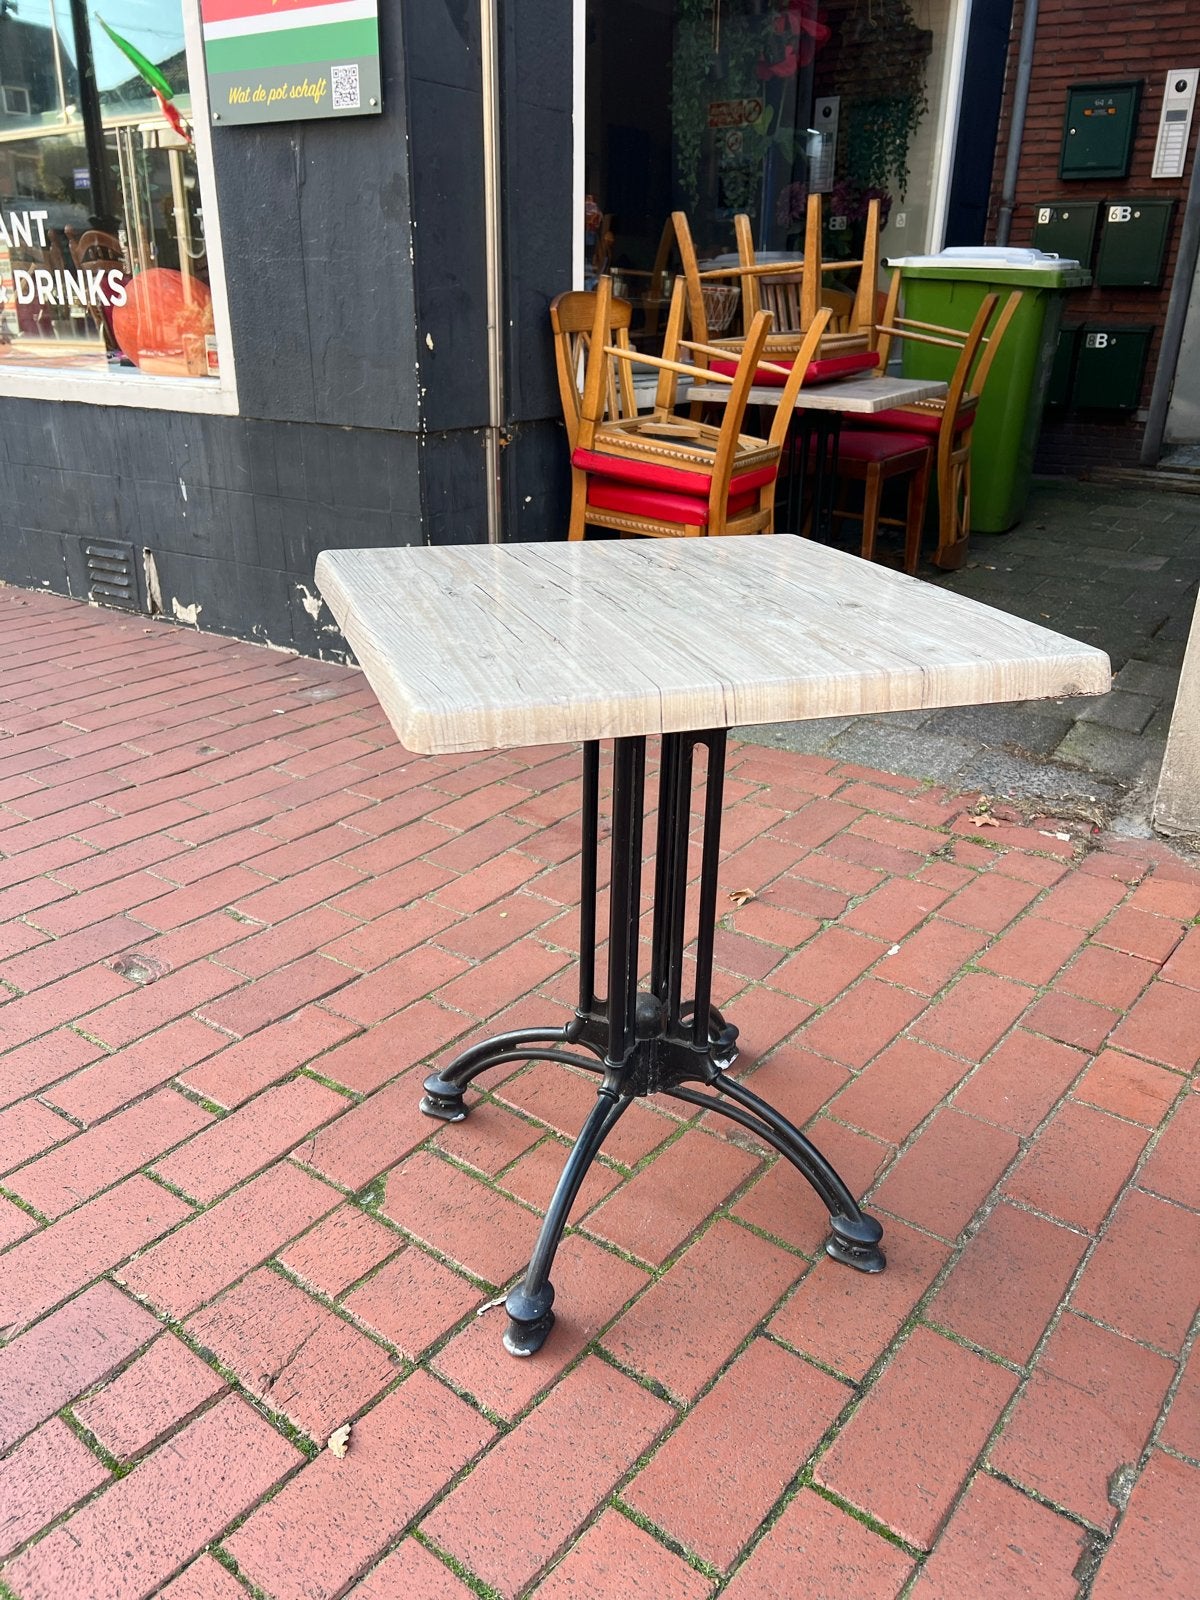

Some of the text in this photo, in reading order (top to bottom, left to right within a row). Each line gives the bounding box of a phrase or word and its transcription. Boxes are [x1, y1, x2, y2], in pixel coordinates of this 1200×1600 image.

[228, 77, 327, 106] Wat de pot schaft
[1109, 205, 1132, 222] 6B
[13, 268, 128, 307] DRINKS
[1087, 332, 1109, 349] 8B
